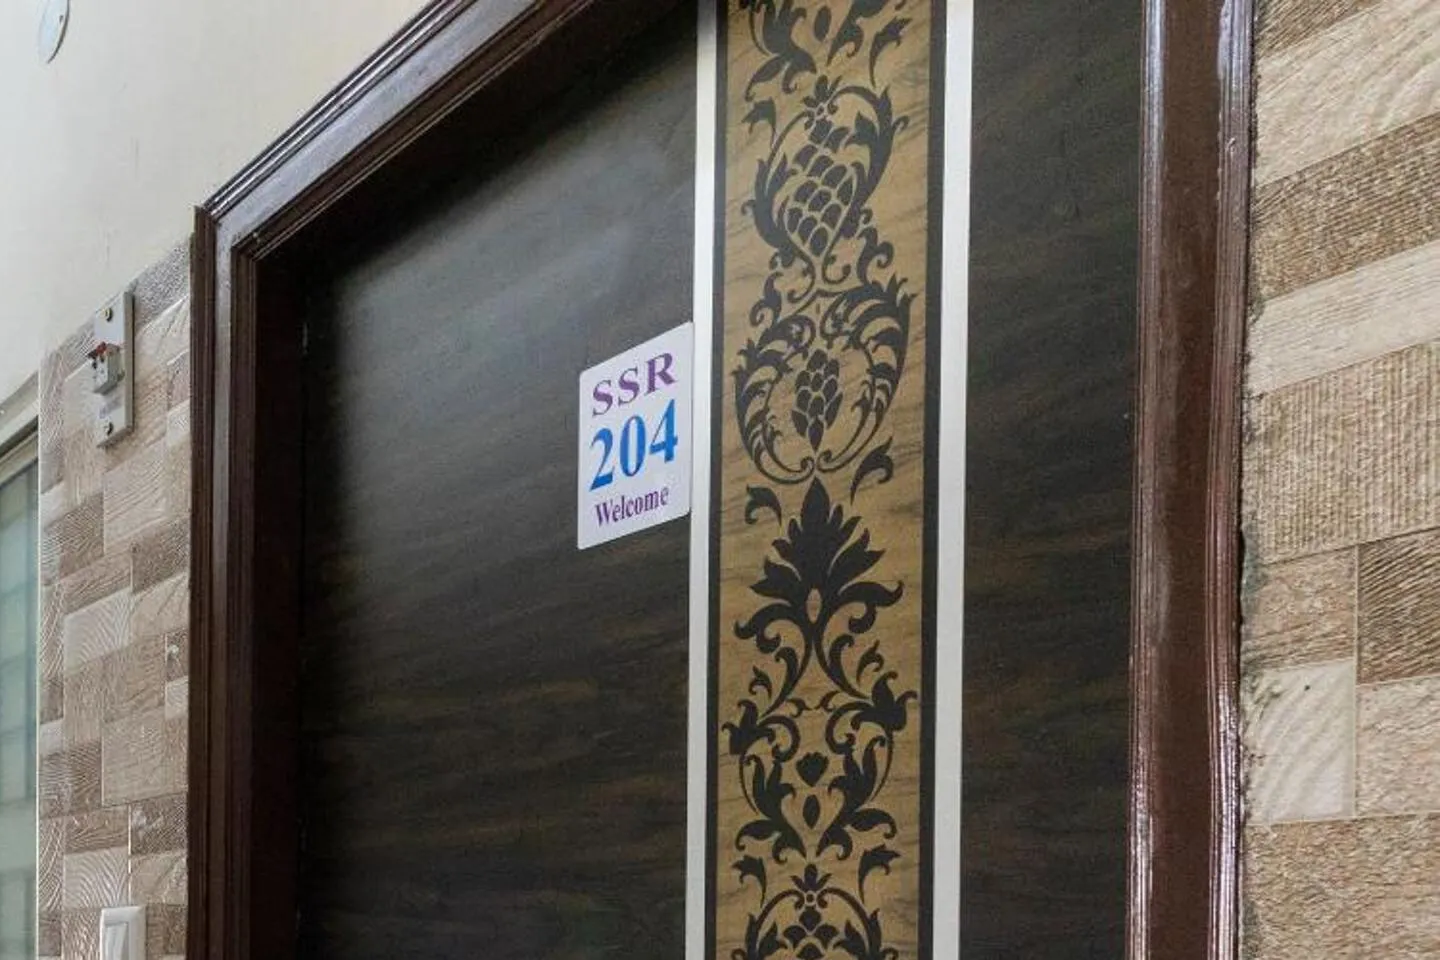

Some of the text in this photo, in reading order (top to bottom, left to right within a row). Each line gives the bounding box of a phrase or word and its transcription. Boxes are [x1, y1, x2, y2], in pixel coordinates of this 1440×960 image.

[592, 353, 676, 416] SSR
[589, 399, 678, 491] 204
[595, 485, 669, 526] Welcome
